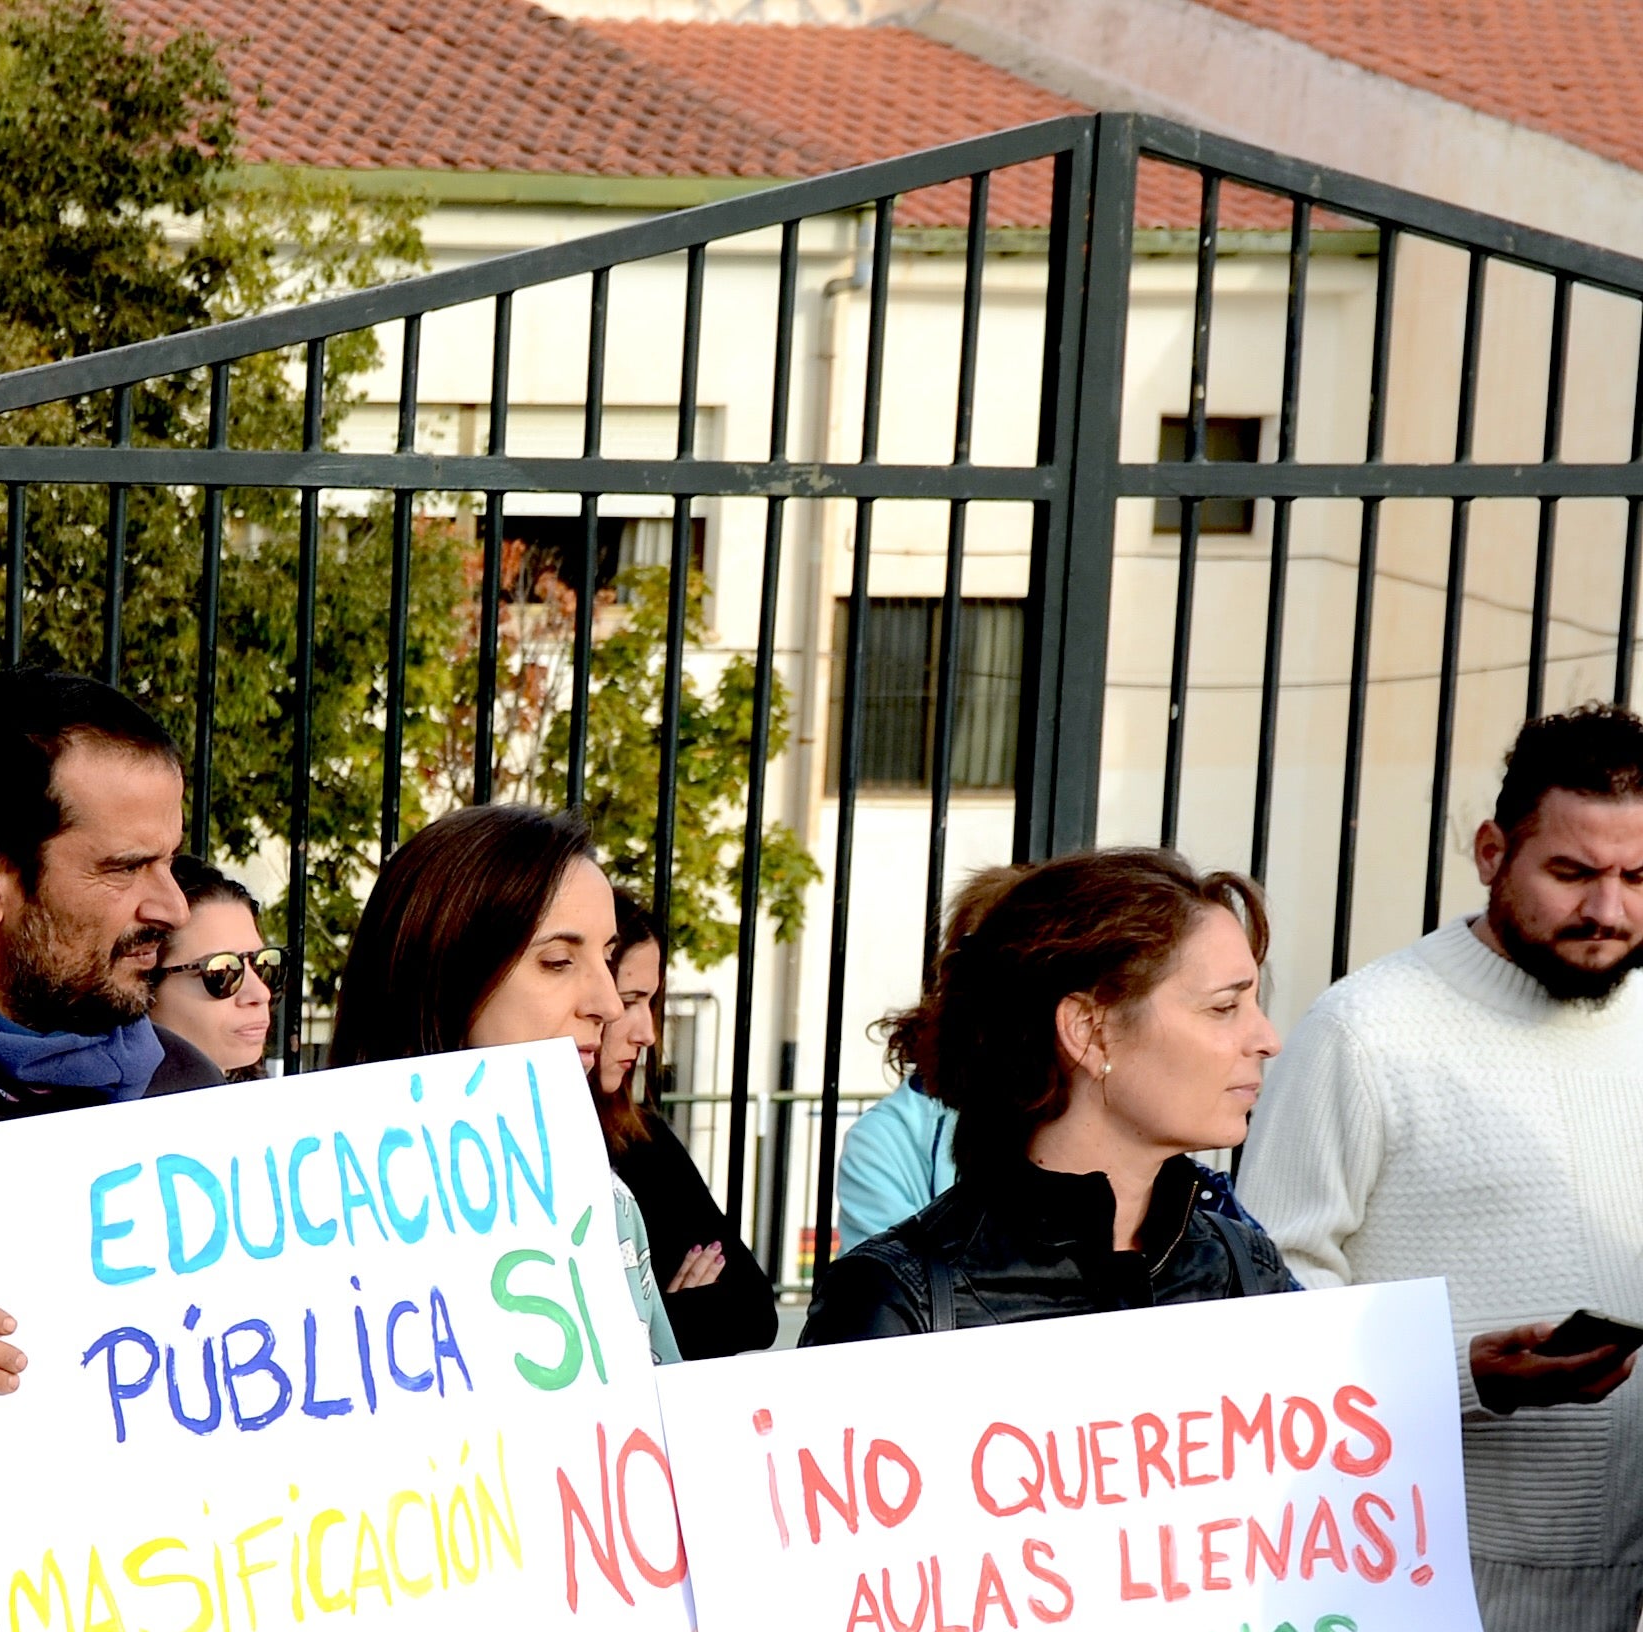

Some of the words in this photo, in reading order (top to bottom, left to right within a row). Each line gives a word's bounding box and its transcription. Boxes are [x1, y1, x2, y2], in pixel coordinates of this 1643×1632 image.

[90, 1060, 557, 1286] EDUCACIÓN
[81, 1276, 473, 1443] PÚBLICA
[491, 1208, 606, 1391] SÍ
[557, 1423, 688, 1612] NO
[971, 1384, 1394, 1517] QUEREMOS
[1118, 1484, 1435, 1602] LLENAS!
